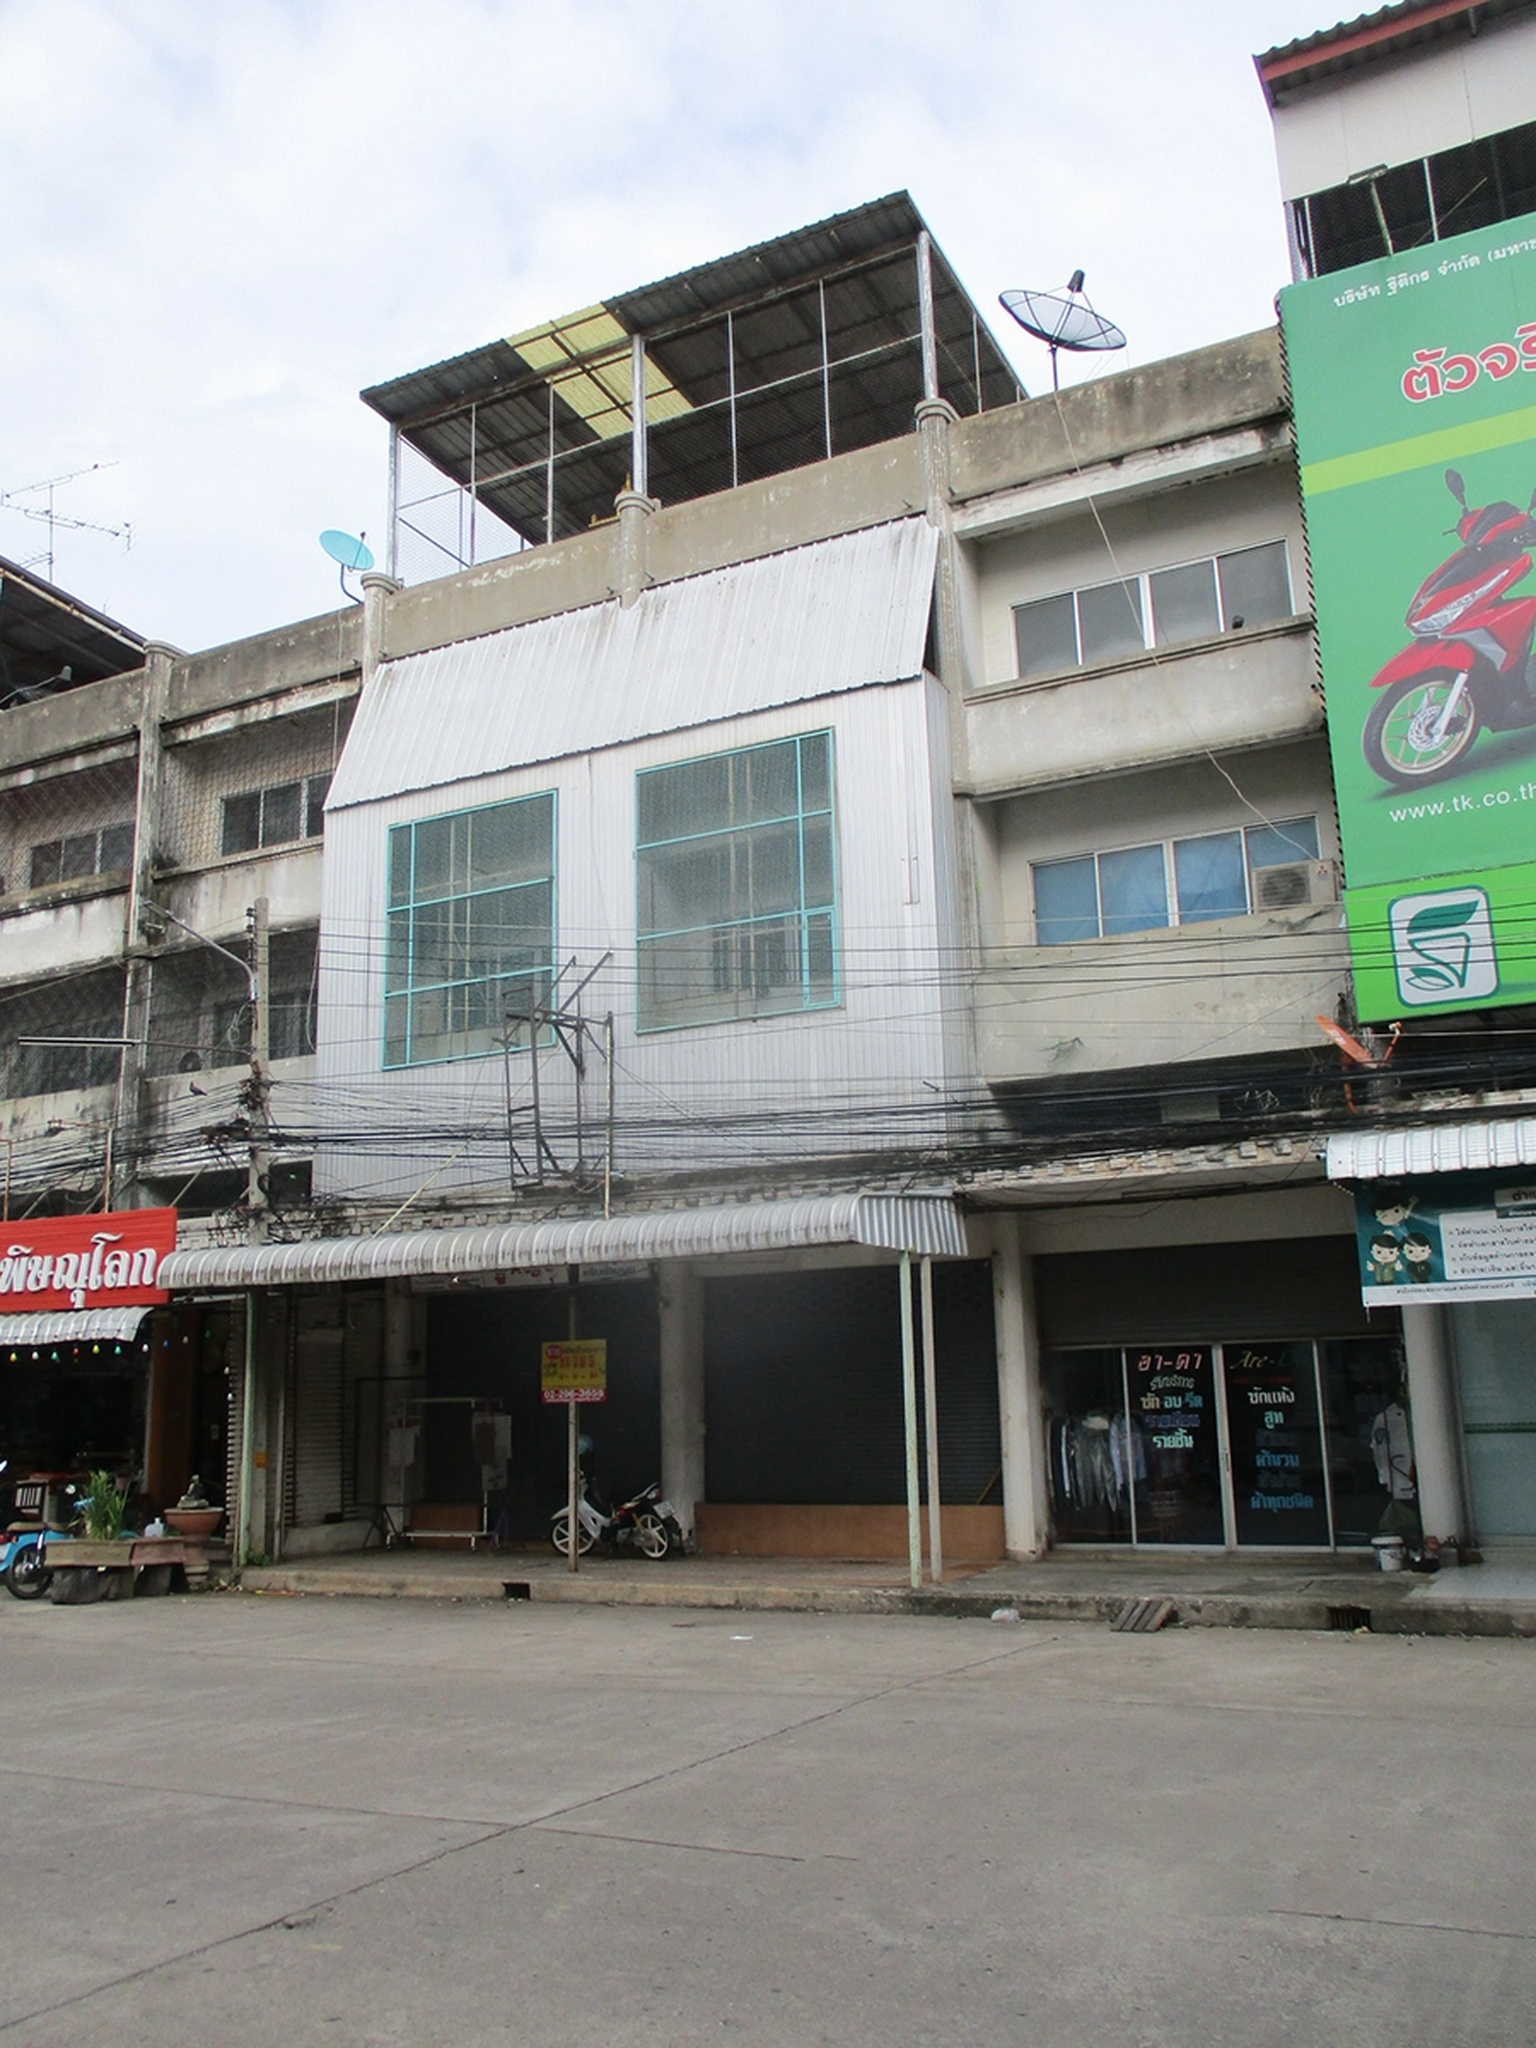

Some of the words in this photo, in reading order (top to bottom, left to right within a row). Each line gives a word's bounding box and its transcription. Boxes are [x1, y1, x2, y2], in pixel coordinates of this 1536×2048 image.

[1333, 284, 1381, 307] บริษัท
[1386, 270, 1430, 296] ฐิติกร
[1437, 254, 1481, 276] จำกัด
[1389, 782, 1536, 823] www.tk.co.th
[0, 1232, 157, 1309] พิษณุโลก
[1247, 1385, 1295, 1405] ซักแห้ง
[1264, 1410, 1285, 1429] สูท
[1250, 1491, 1314, 1513] ผ้าทุกชนิด
